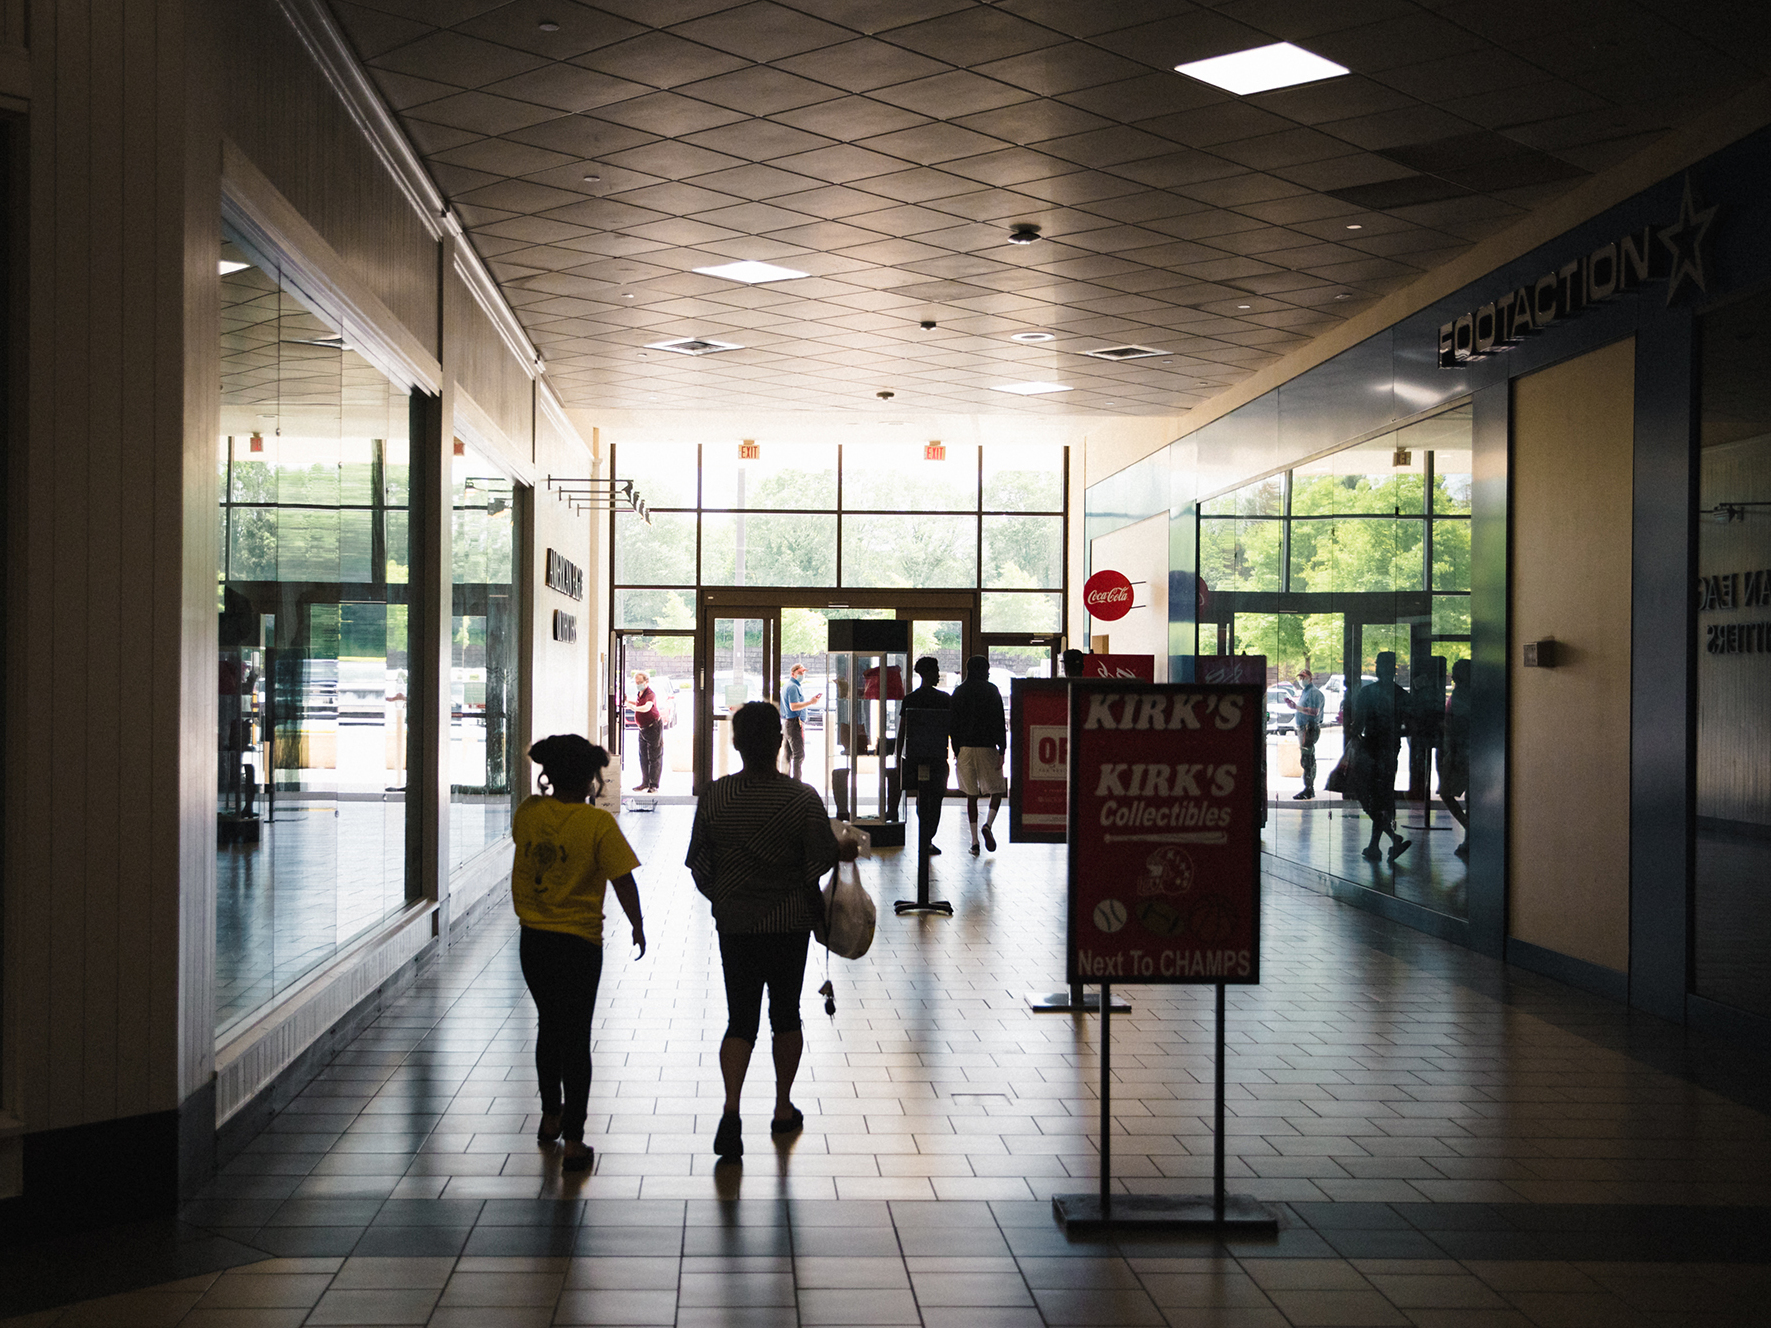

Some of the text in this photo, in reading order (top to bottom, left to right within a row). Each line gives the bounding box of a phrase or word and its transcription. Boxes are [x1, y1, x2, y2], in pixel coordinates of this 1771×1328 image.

[1438, 225, 1649, 369] FOOTACTION
[741, 446, 758, 459] EXIT
[926, 446, 944, 460] EXIT
[1083, 693, 1245, 732] KIRK'S
[1094, 763, 1239, 798] KIRK'S
[1099, 800, 1232, 828] Collectibles
[1077, 949, 1252, 977] Next To CHAMPS
